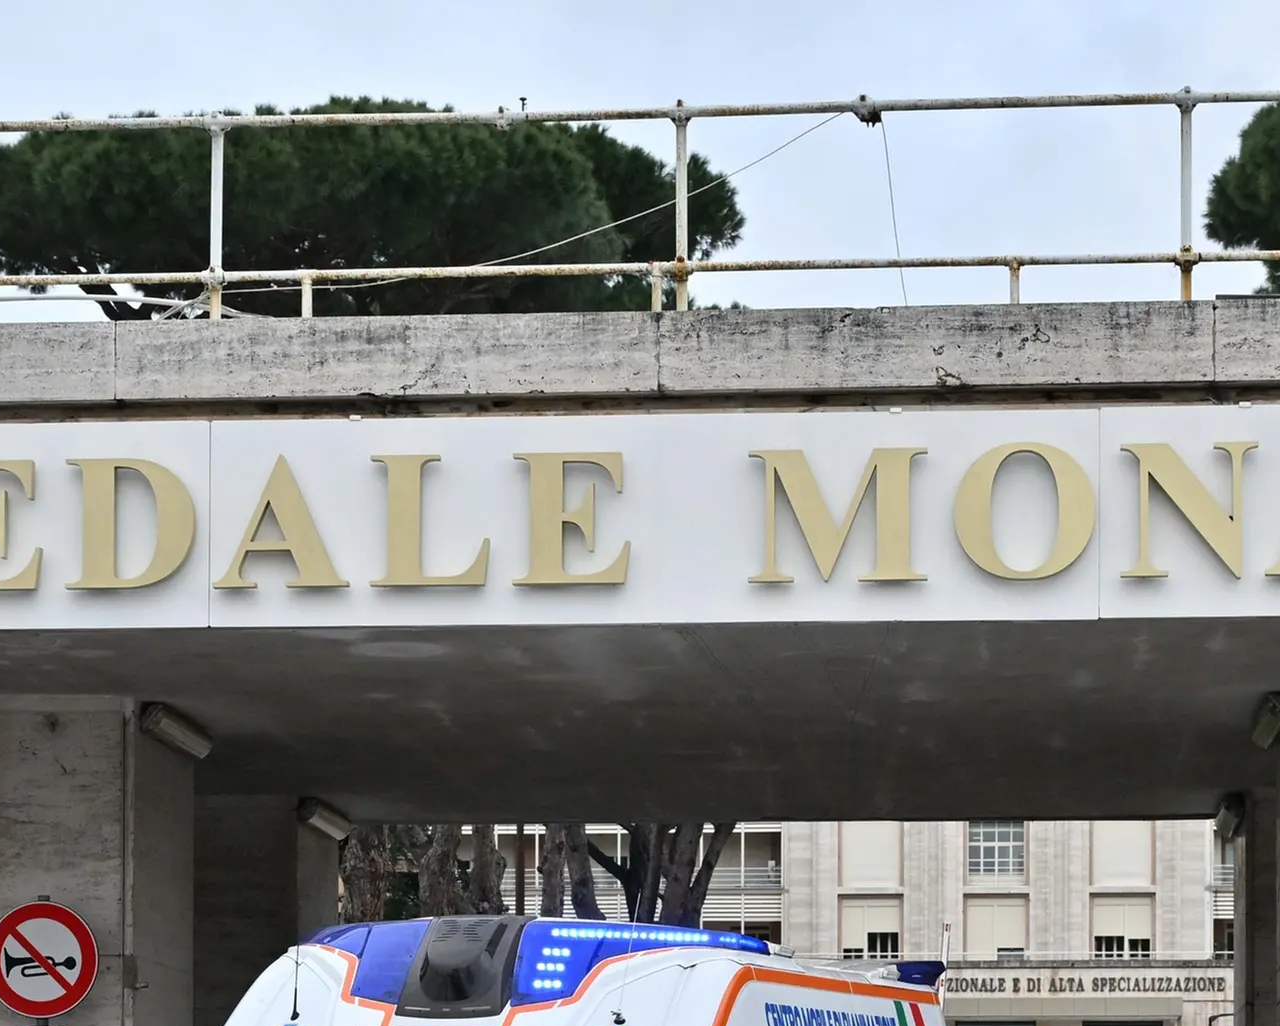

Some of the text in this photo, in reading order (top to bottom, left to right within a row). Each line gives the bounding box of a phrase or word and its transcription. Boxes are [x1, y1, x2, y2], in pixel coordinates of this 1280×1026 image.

[946, 976, 1227, 993] ZIONALE E DI ALTA SPECIALIZZAZIONE
